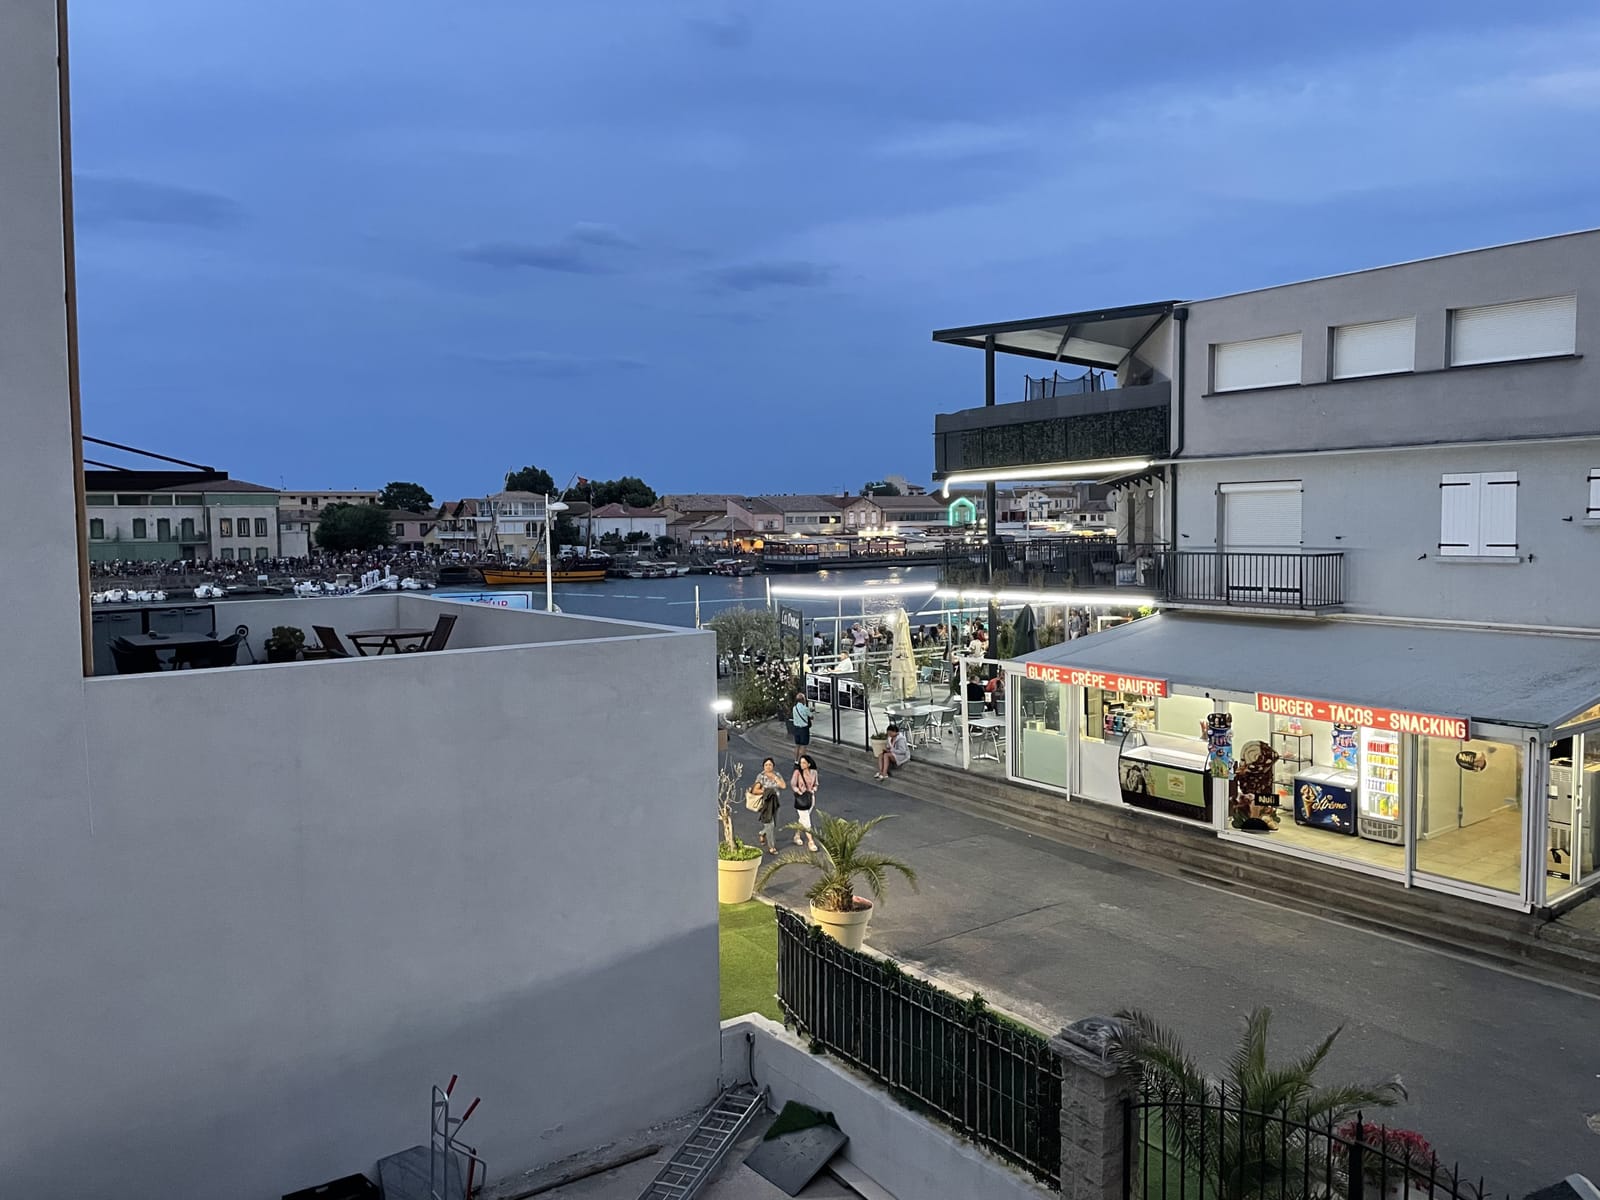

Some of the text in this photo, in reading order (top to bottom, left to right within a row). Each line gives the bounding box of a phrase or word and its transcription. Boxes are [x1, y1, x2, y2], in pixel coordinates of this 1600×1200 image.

[1028, 666, 1060, 682] GLACE
[1071, 670, 1106, 689] CRÊPE
[1118, 678, 1162, 696] GAUFRE
[1262, 696, 1314, 717] BURGER
[1328, 705, 1373, 726] TACOS
[1390, 713, 1466, 739] SNACKING
